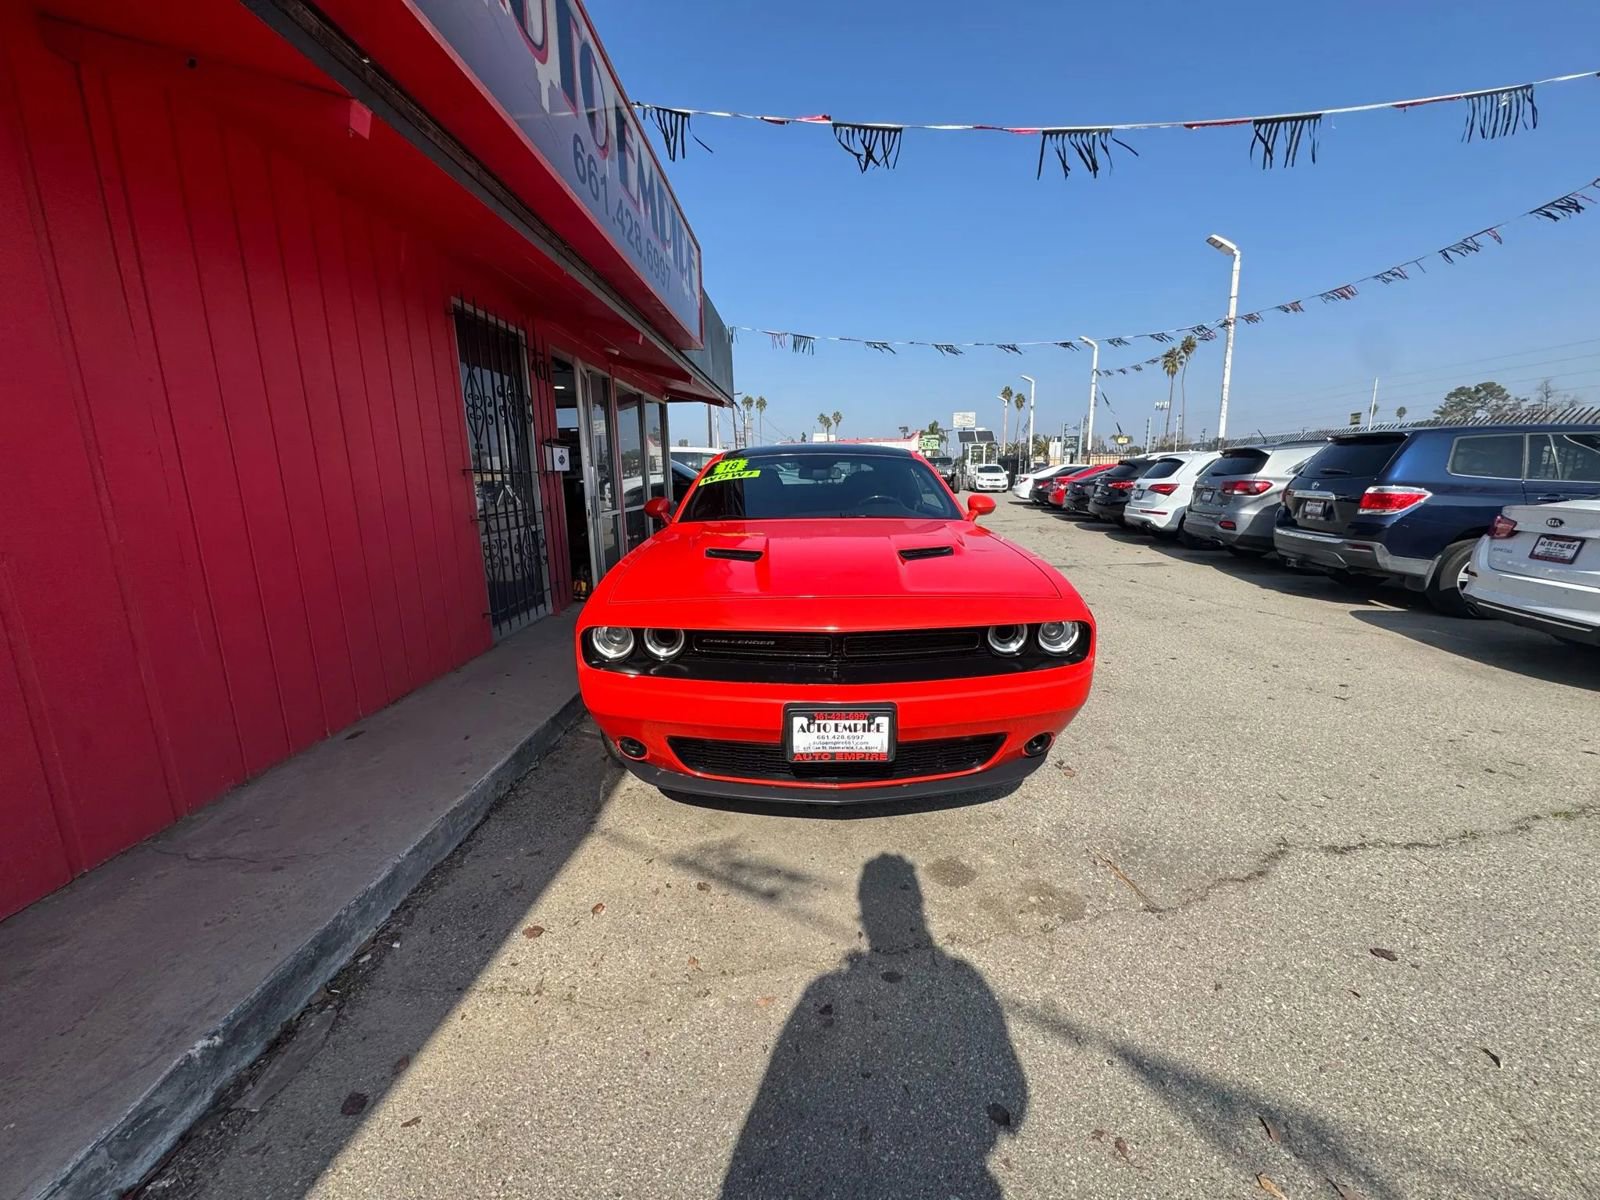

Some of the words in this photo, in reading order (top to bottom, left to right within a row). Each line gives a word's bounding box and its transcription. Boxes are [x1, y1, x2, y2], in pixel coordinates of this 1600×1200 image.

[572, 133, 671, 291] 661.428.6997
[702, 638, 776, 646] CHALLENGER
[797, 722, 832, 733] AUTO
[834, 722, 885, 733] EMPIRE
[794, 752, 832, 760] AUTO
[835, 752, 888, 760] EMPIRE
